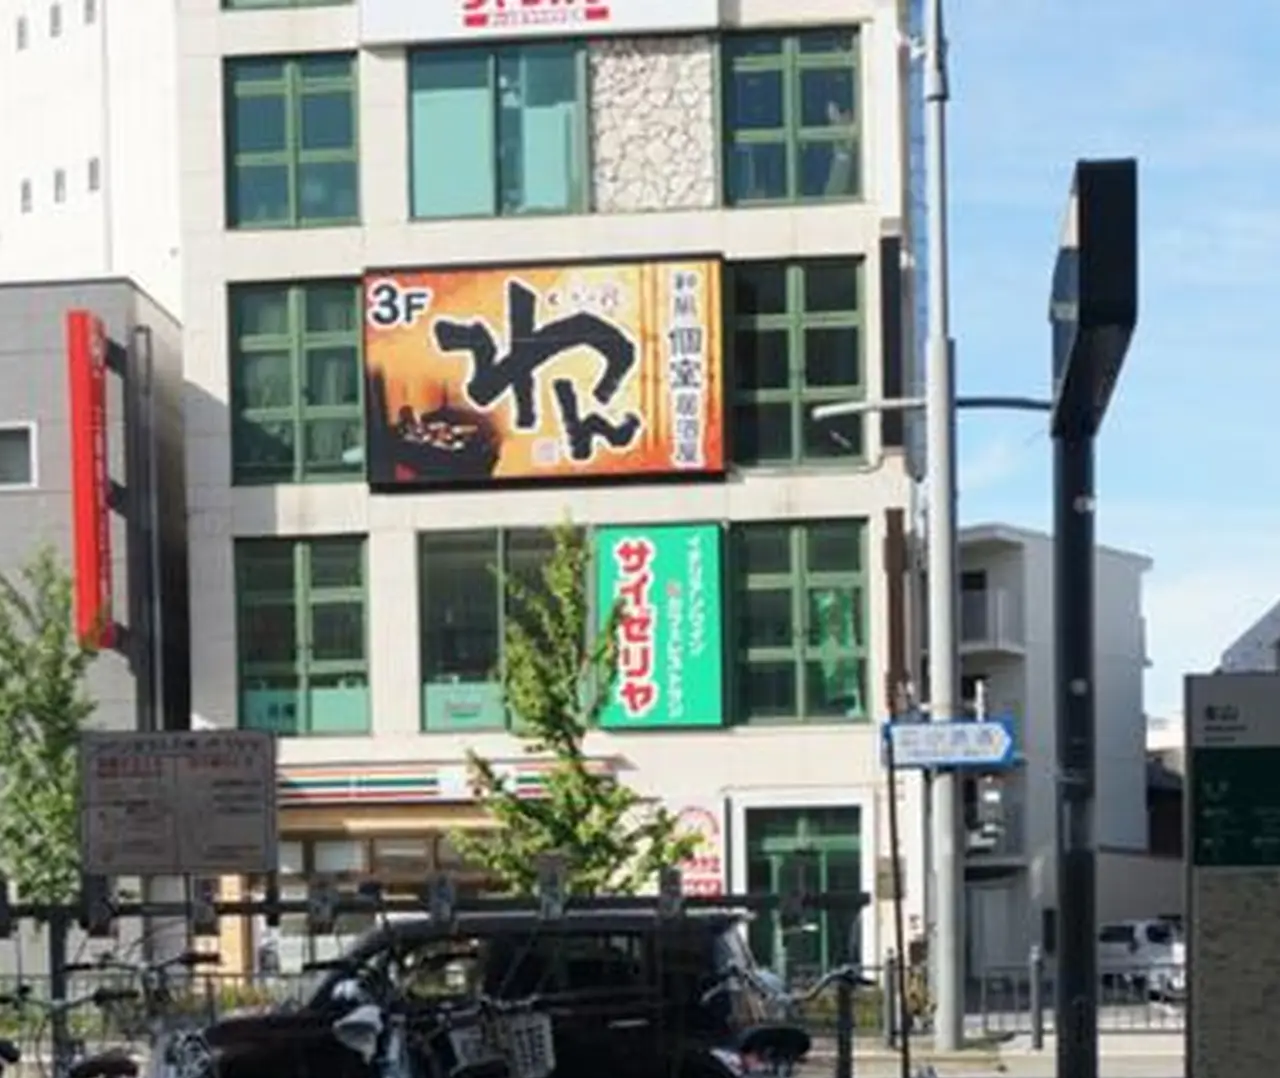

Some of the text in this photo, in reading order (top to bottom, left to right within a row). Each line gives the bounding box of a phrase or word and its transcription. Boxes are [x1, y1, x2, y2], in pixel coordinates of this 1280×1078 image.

[371, 283, 428, 325] 3F
[433, 280, 642, 461] わん
[615, 538, 657, 716] サイゼリヤ
